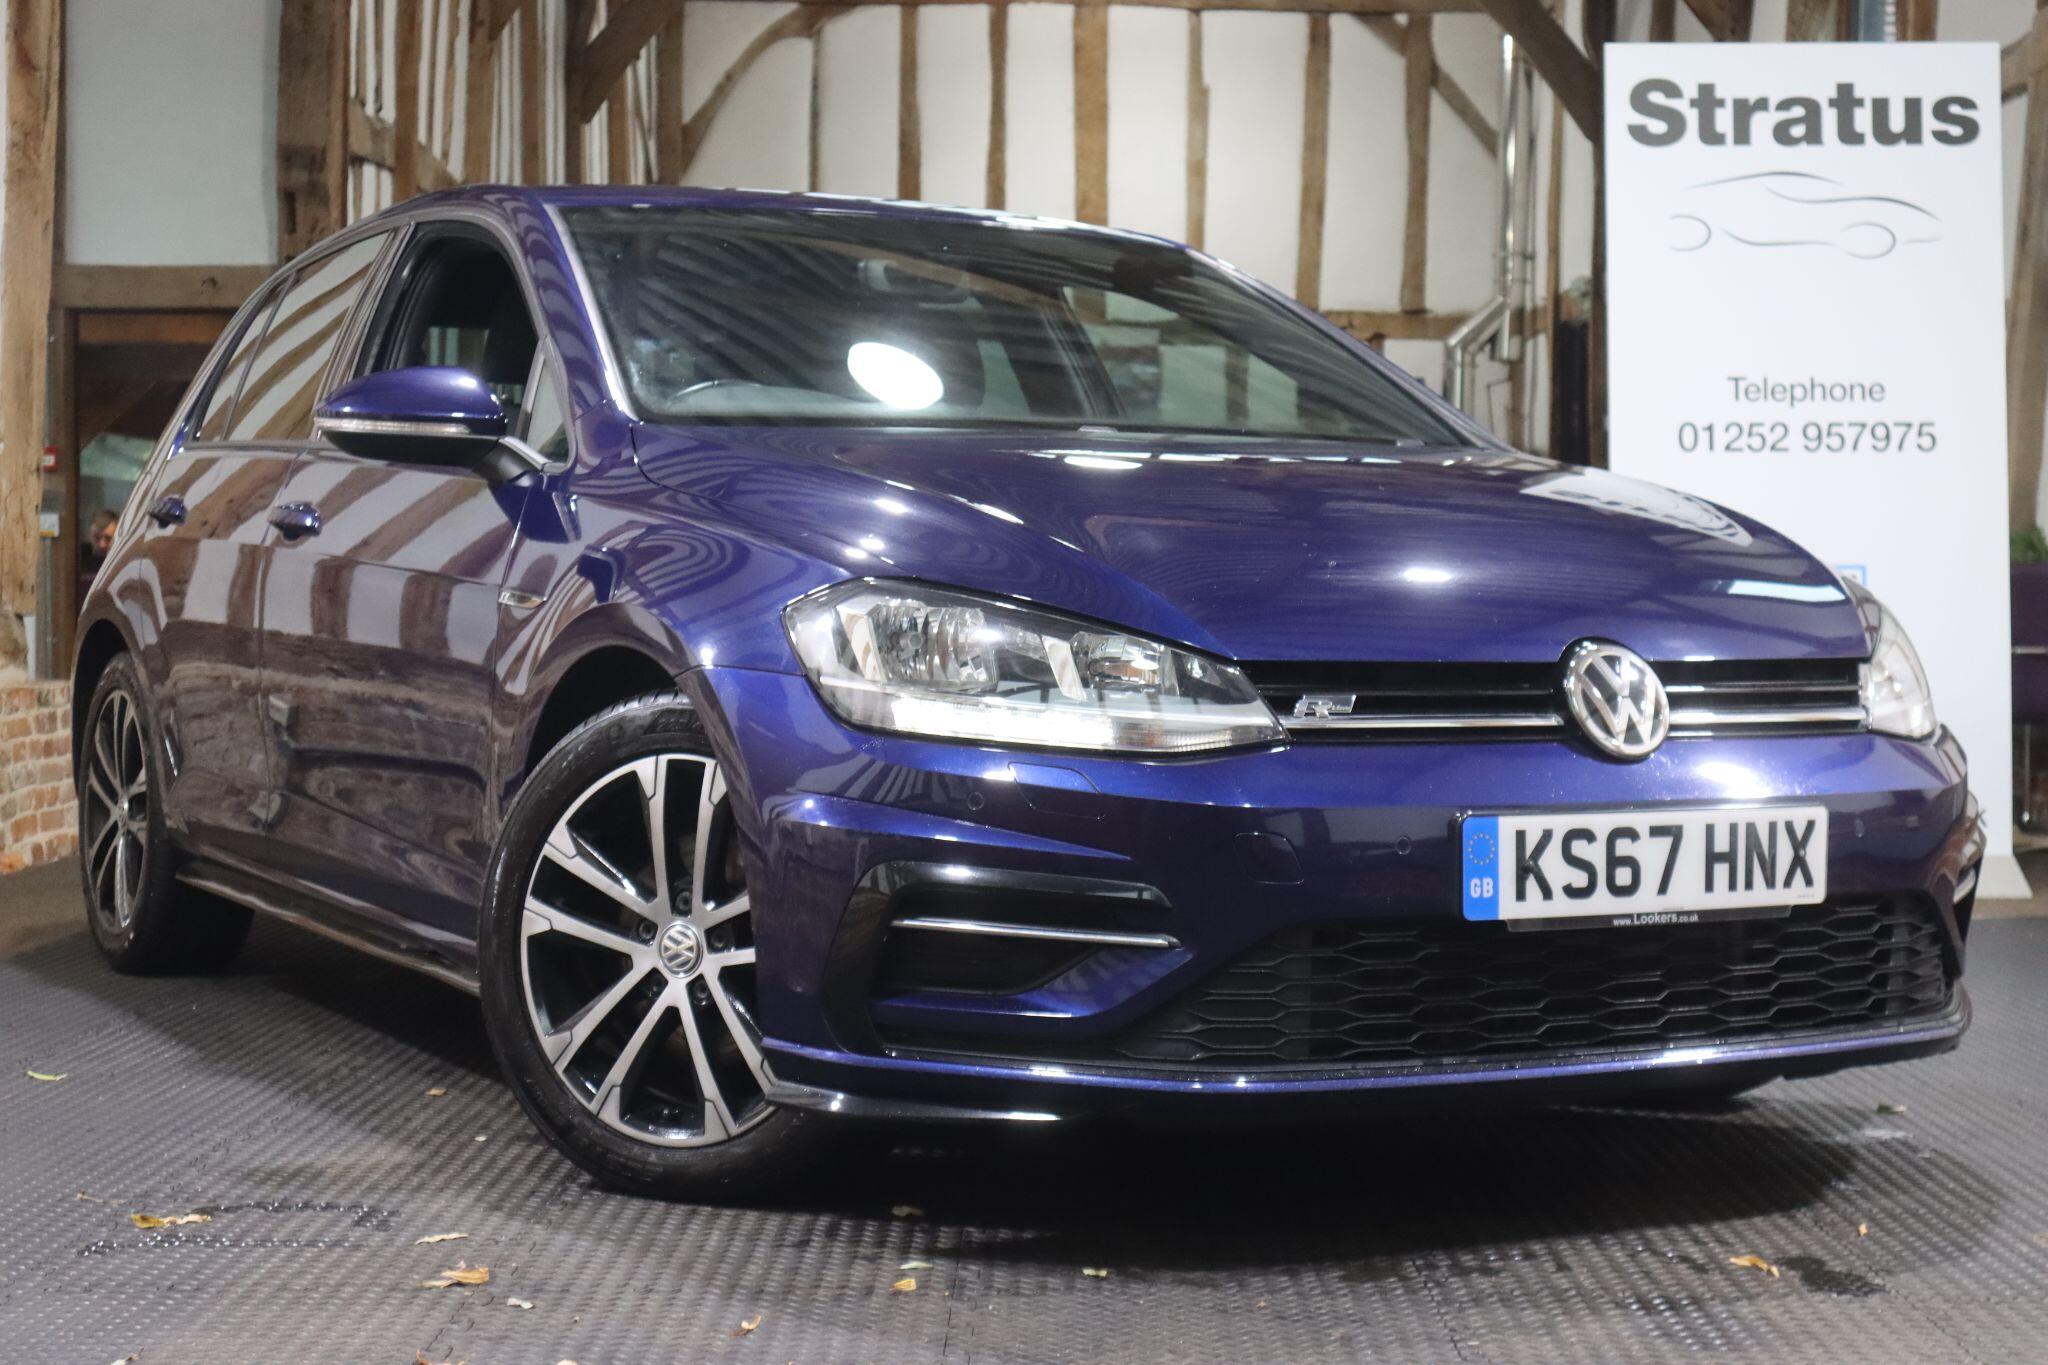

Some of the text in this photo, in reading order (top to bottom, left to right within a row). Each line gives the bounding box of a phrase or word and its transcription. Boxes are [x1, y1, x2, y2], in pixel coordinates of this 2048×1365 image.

[1627, 78, 1980, 147] Stratus
[1728, 376, 1886, 407] Telephone
[1678, 422, 1937, 453] 01252 957975
[1515, 819, 1816, 902] KS67 HNX
[1470, 877, 1494, 898] GB
[1613, 912, 1699, 927] www.Lookers.co.uk
